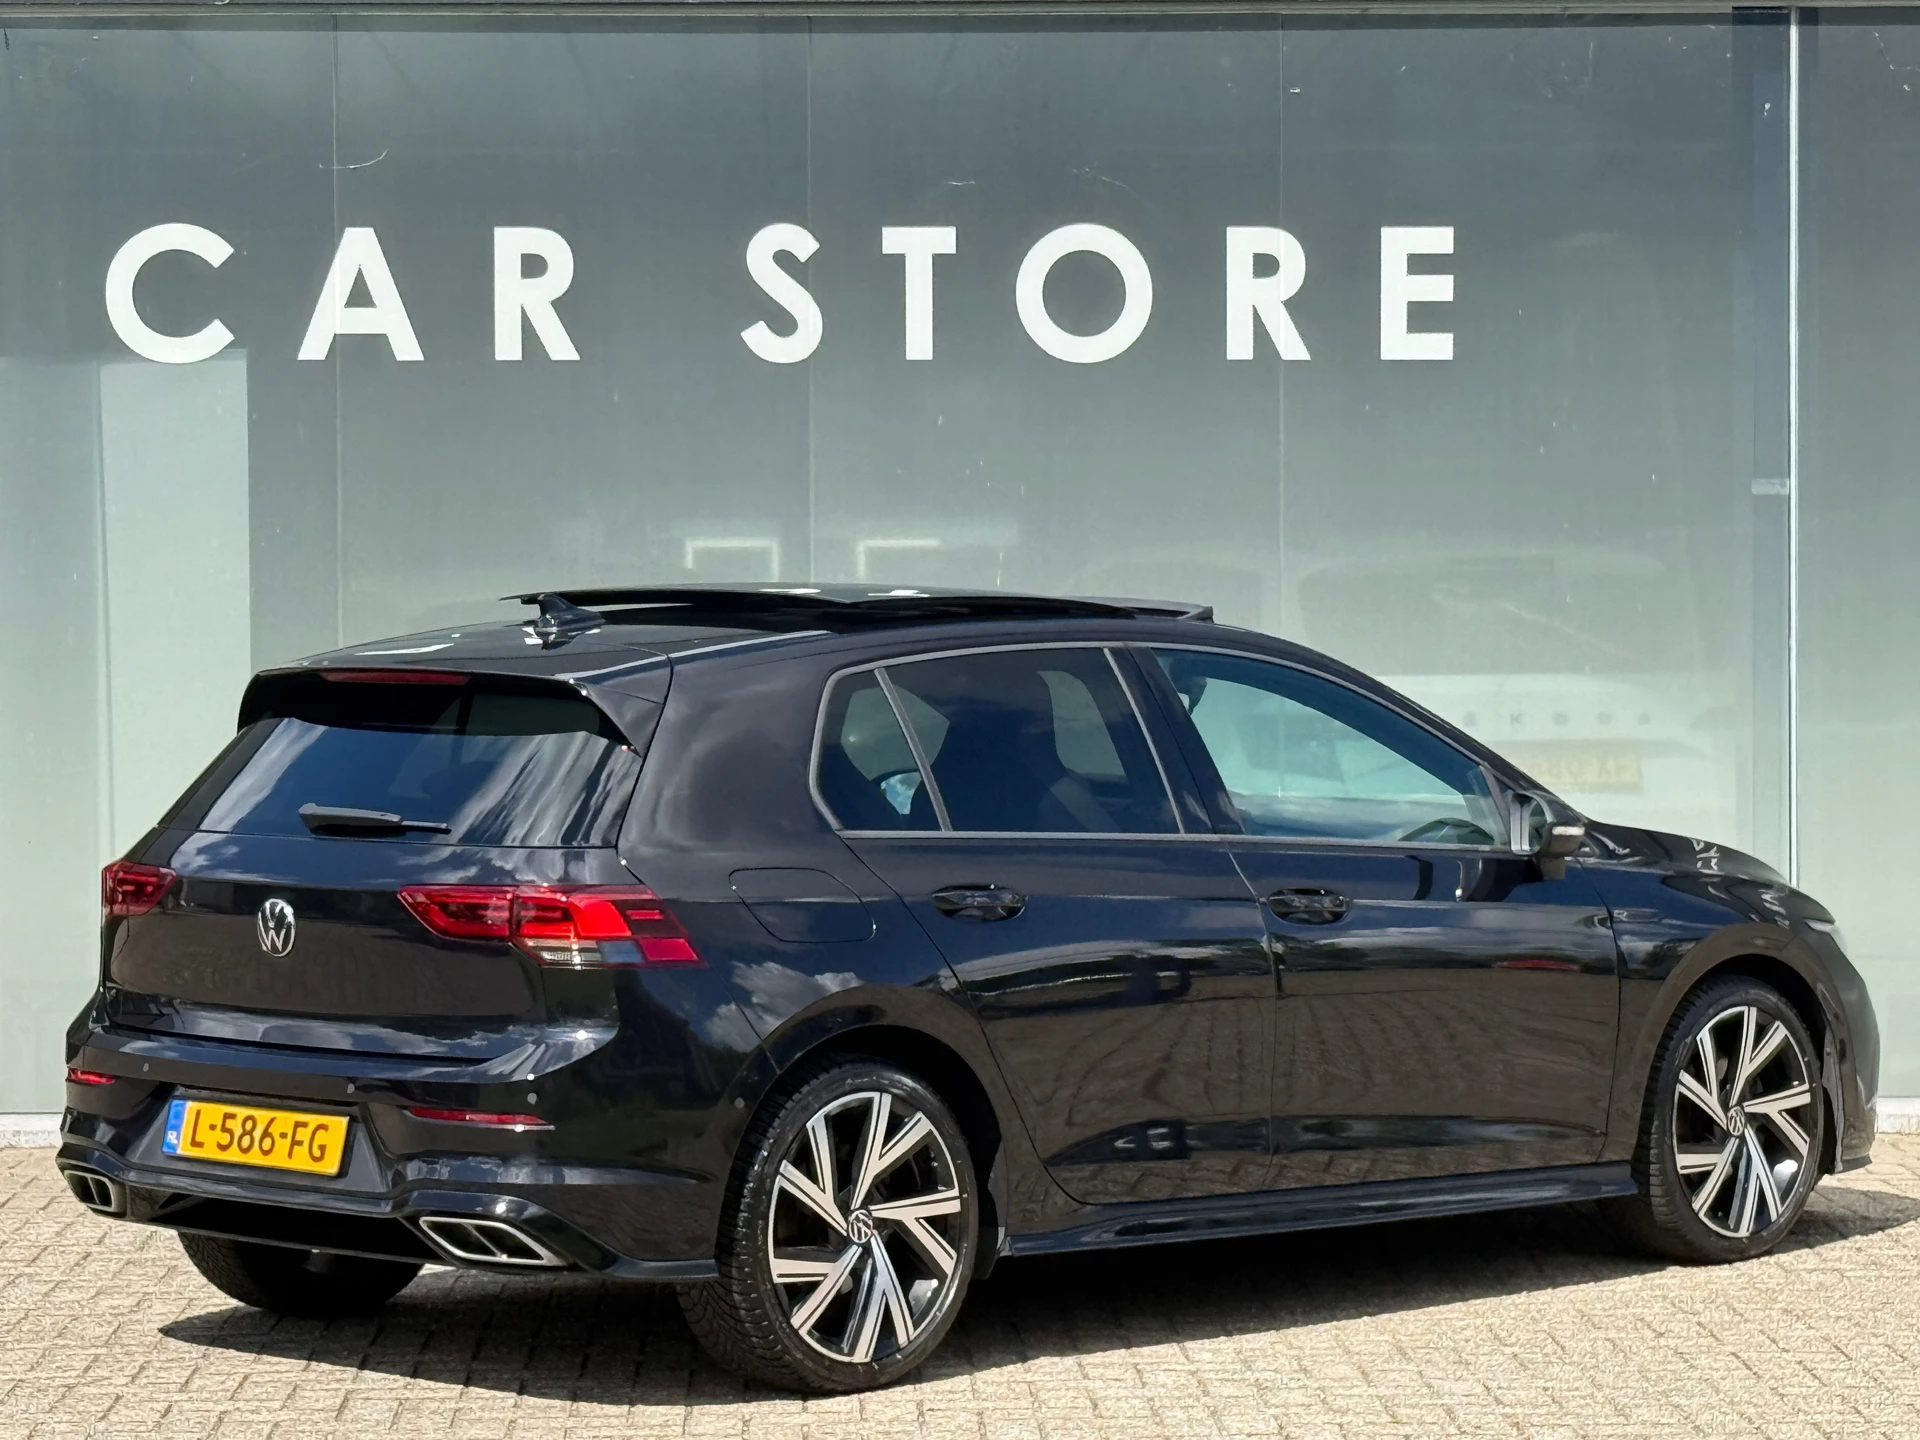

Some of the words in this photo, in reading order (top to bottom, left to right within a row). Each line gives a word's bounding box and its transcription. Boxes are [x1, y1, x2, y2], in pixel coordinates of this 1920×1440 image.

[105, 223, 581, 364] CAR
[740, 223, 1455, 364] STORE
[190, 1109, 329, 1163] L-586-FG
